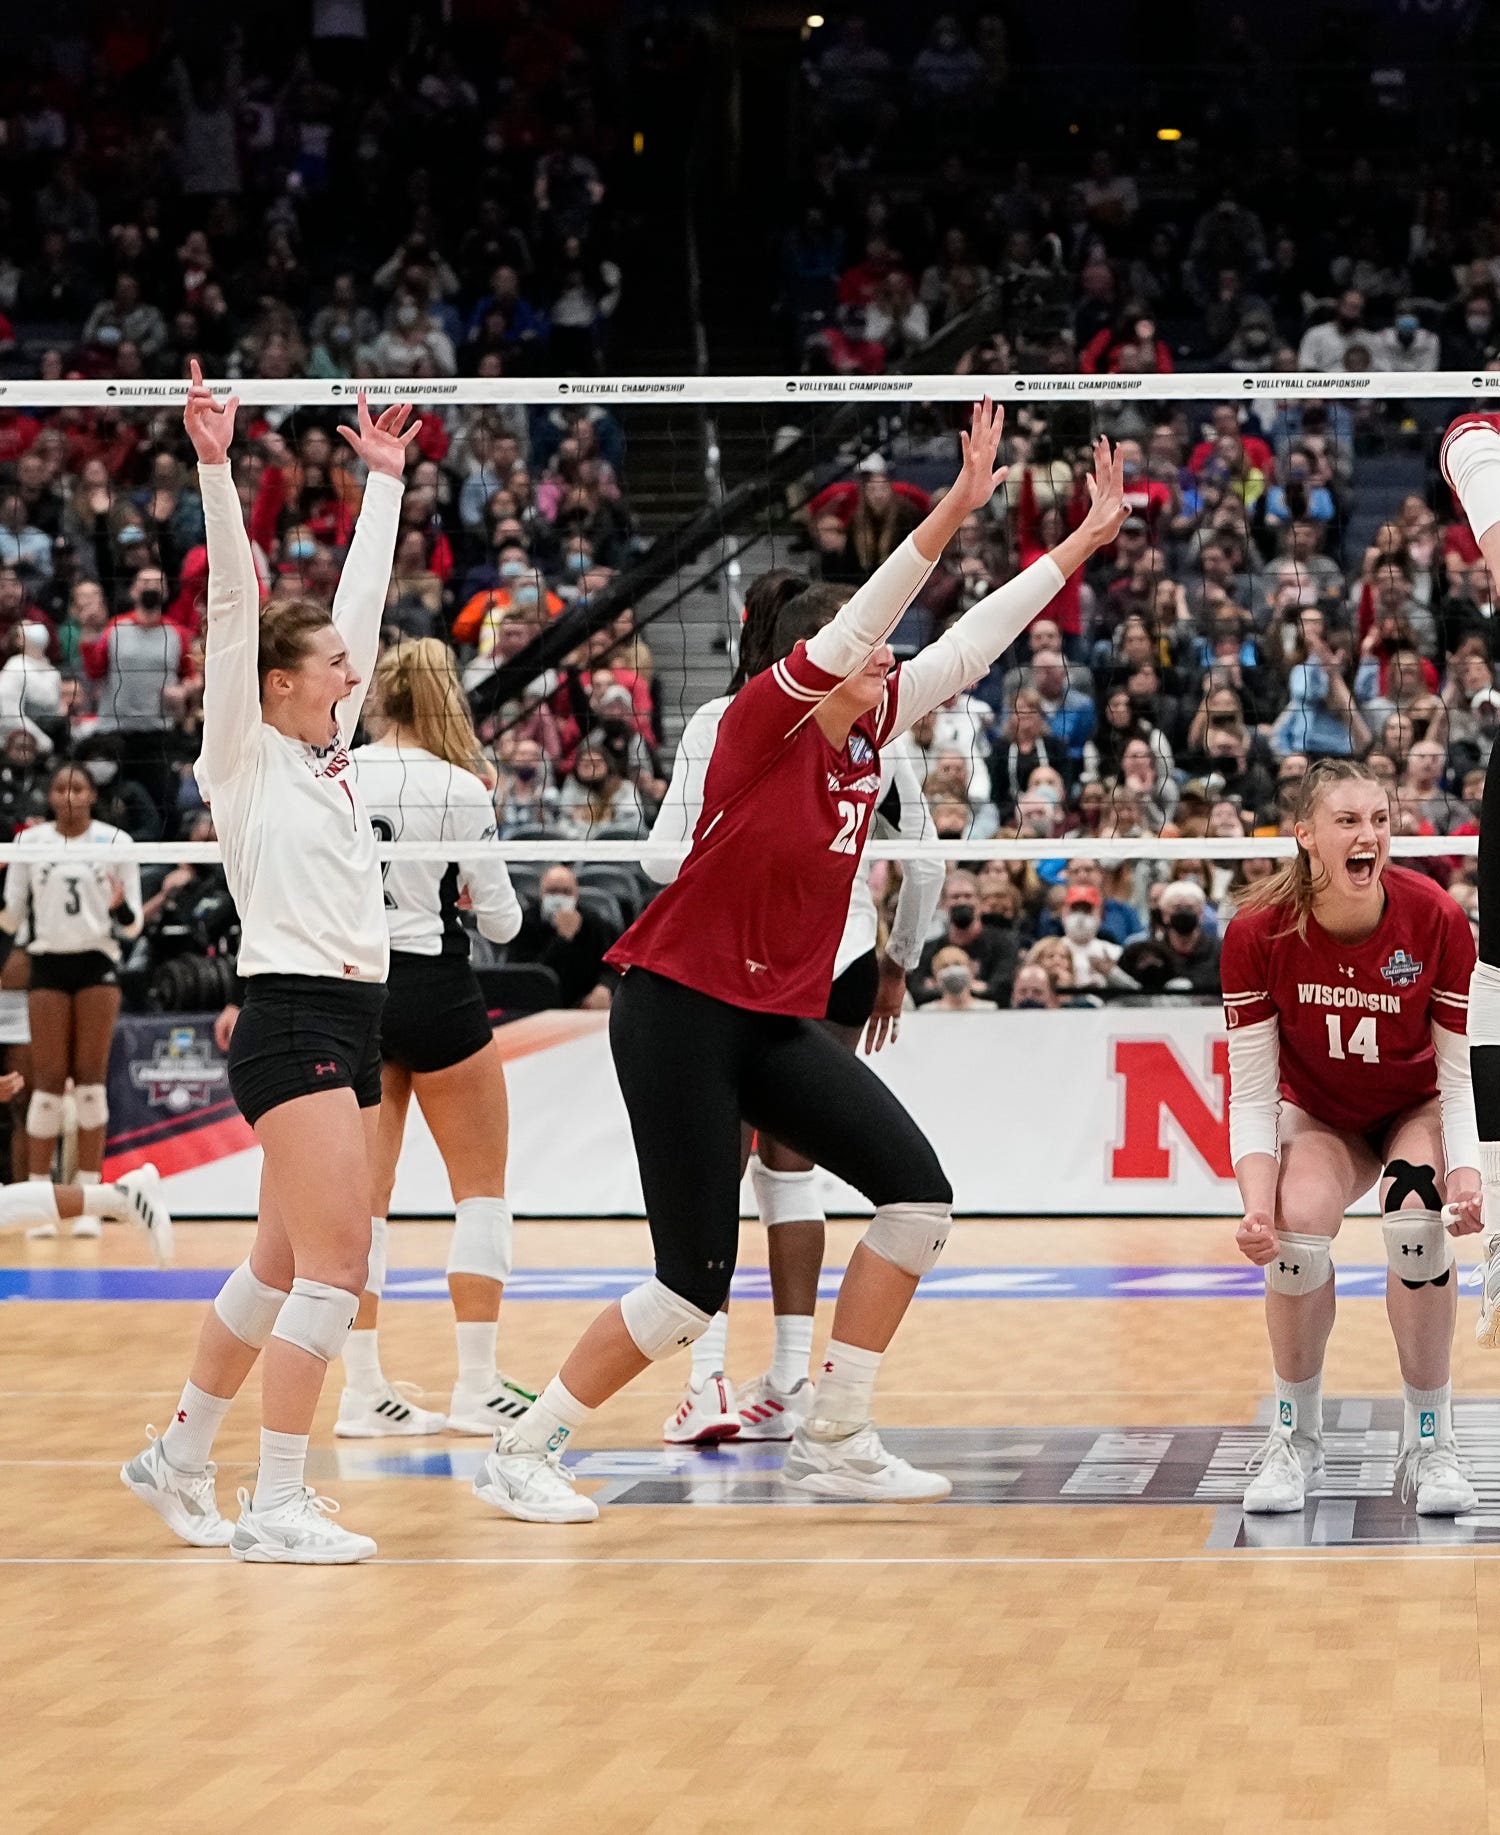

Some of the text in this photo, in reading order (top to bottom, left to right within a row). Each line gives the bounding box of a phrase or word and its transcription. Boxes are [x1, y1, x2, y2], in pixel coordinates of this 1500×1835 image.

[571, 383, 685, 394] VOLLEYBALL CHAMPIONSHIP
[798, 382, 913, 392] VOLLEYBALL CHAMPIONSHIP
[1028, 380, 1142, 391] VOLLEYBALL CHAMPIONSHIP
[1256, 379, 1370, 389] VOLLEYBALL CHAMPIONSHIP
[119, 386, 232, 396] VOLLEYBALL CHASHIP
[344, 385, 457, 395] VOLLEYBALL CHAMPIONSHIP
[828, 801, 867, 855] 21
[65, 878, 81, 915] 3
[1297, 983, 1401, 1014] WISCONSIN
[1325, 1014, 1380, 1063] 14
[1108, 1036, 1236, 1182] N
